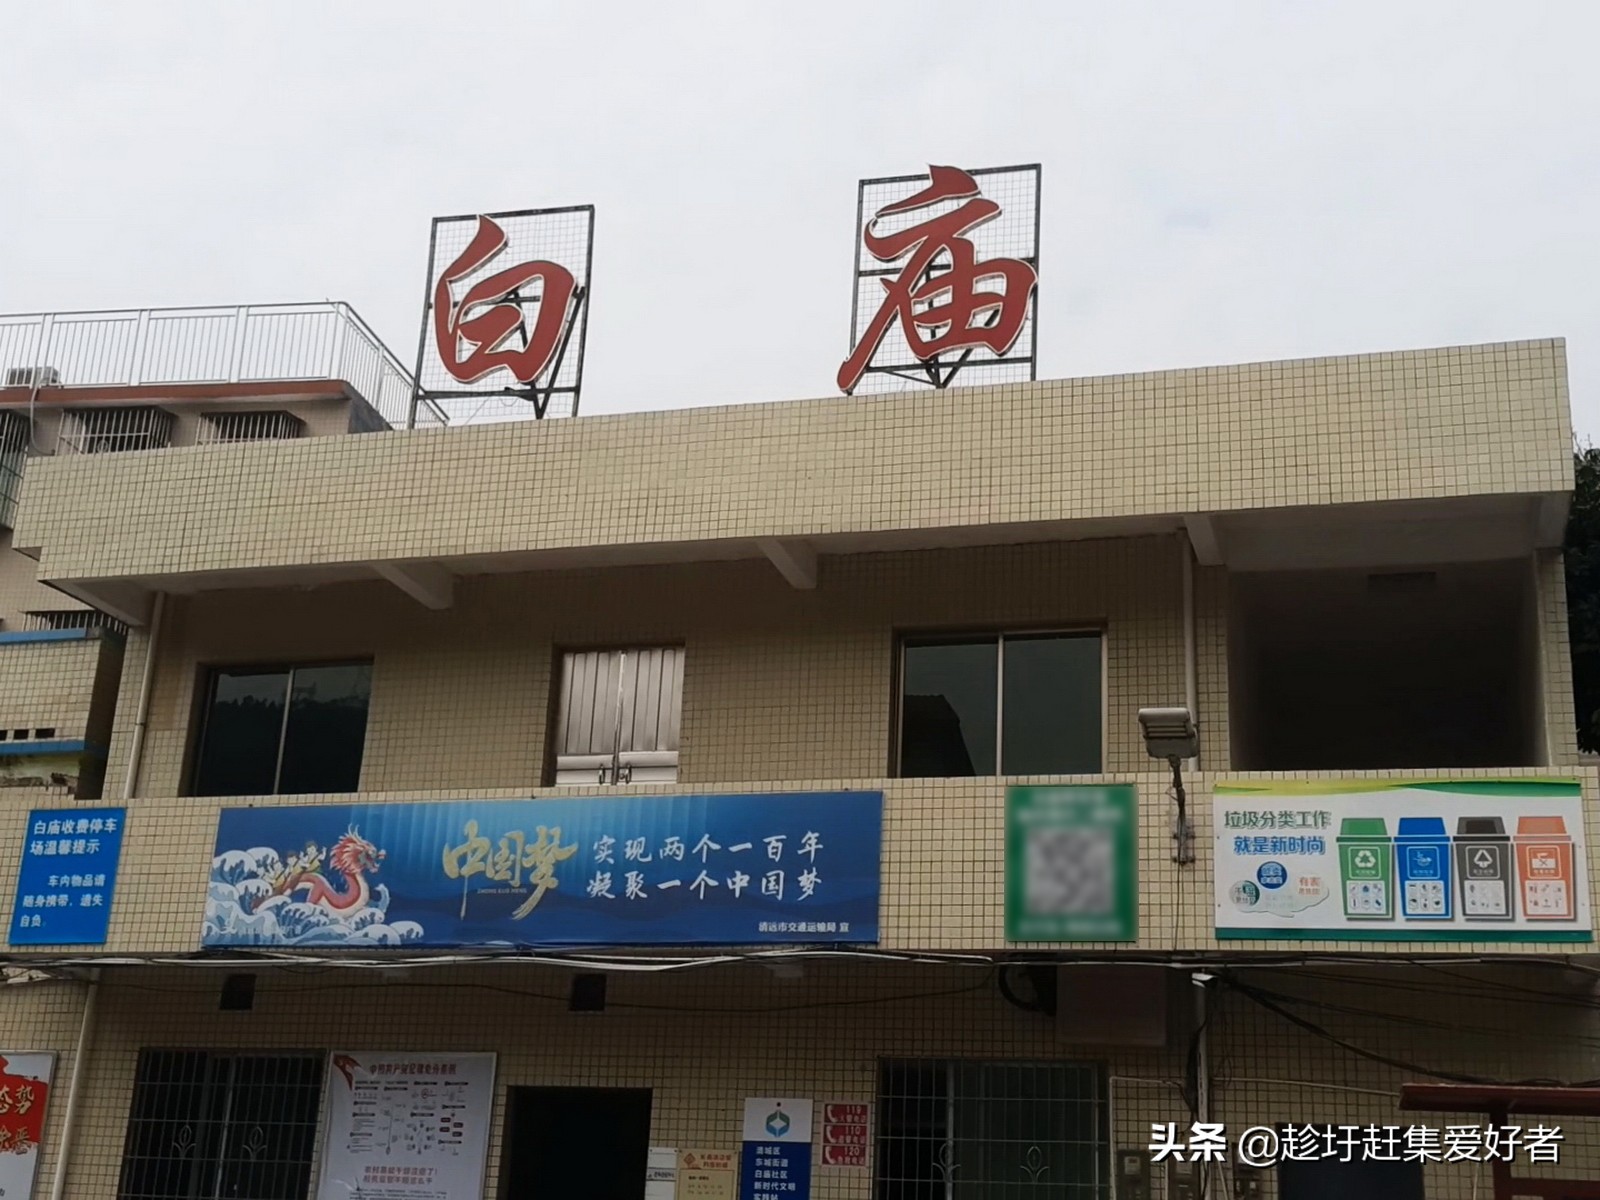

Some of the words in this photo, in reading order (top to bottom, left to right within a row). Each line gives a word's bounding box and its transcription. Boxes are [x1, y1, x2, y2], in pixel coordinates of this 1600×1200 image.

[33, 818, 118, 835] 白庙收费停车
[1224, 810, 1331, 829] 垃圾分类工作
[30, 839, 100, 855] 场温馨提示
[593, 831, 824, 864] 实现两个一百年
[1233, 835, 1327, 855] 就是新时尚
[442, 819, 579, 920] 中国梦
[48, 874, 106, 887] 车内物品请
[587, 867, 822, 901] 凝聚一个中国梦
[758, 922, 836, 932] 清远市交通运输局
[845, 1126, 861, 1135] 110
[844, 1146, 860, 1156] 120
[754, 1181, 796, 1191] 新时代文明
